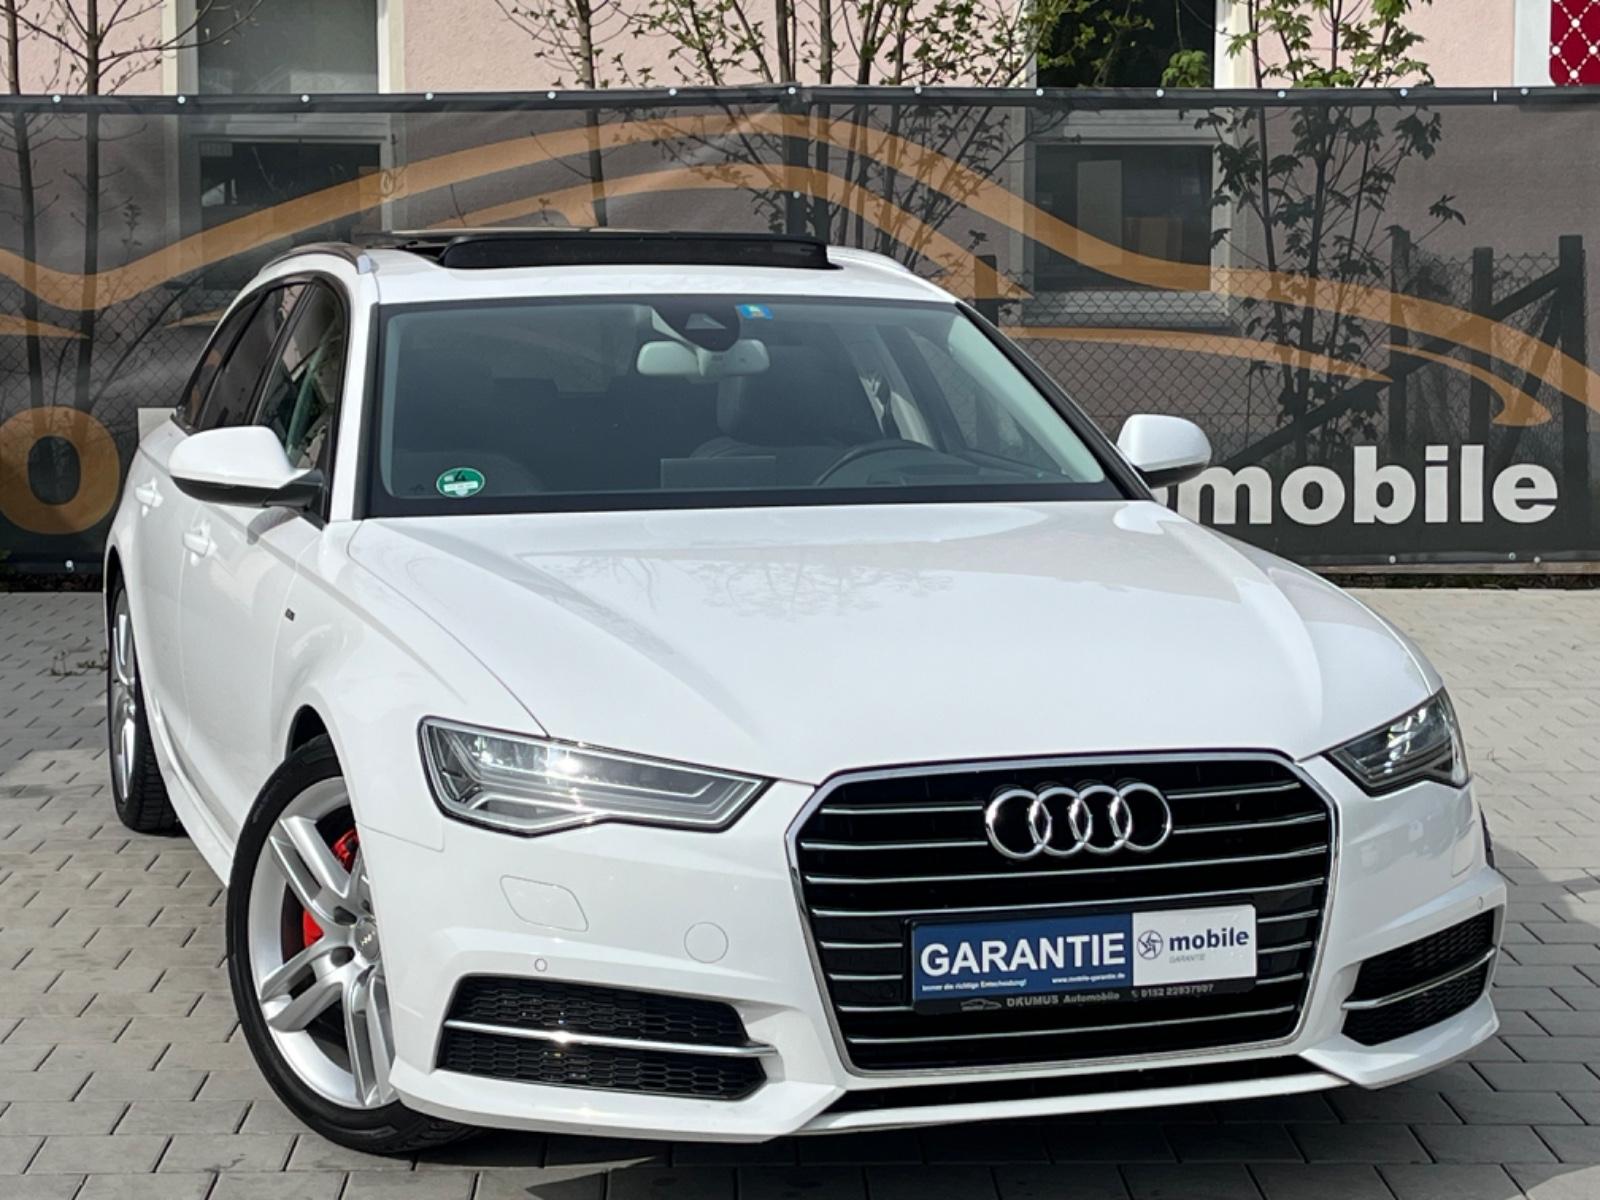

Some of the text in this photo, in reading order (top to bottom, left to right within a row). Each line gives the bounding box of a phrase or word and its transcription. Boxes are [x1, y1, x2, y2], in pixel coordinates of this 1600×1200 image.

[1150, 444, 1558, 525] mobile
[920, 932, 1125, 977] GARANTIE
[1168, 927, 1250, 952] mobile
[1063, 991, 1120, 1004] Automobile
